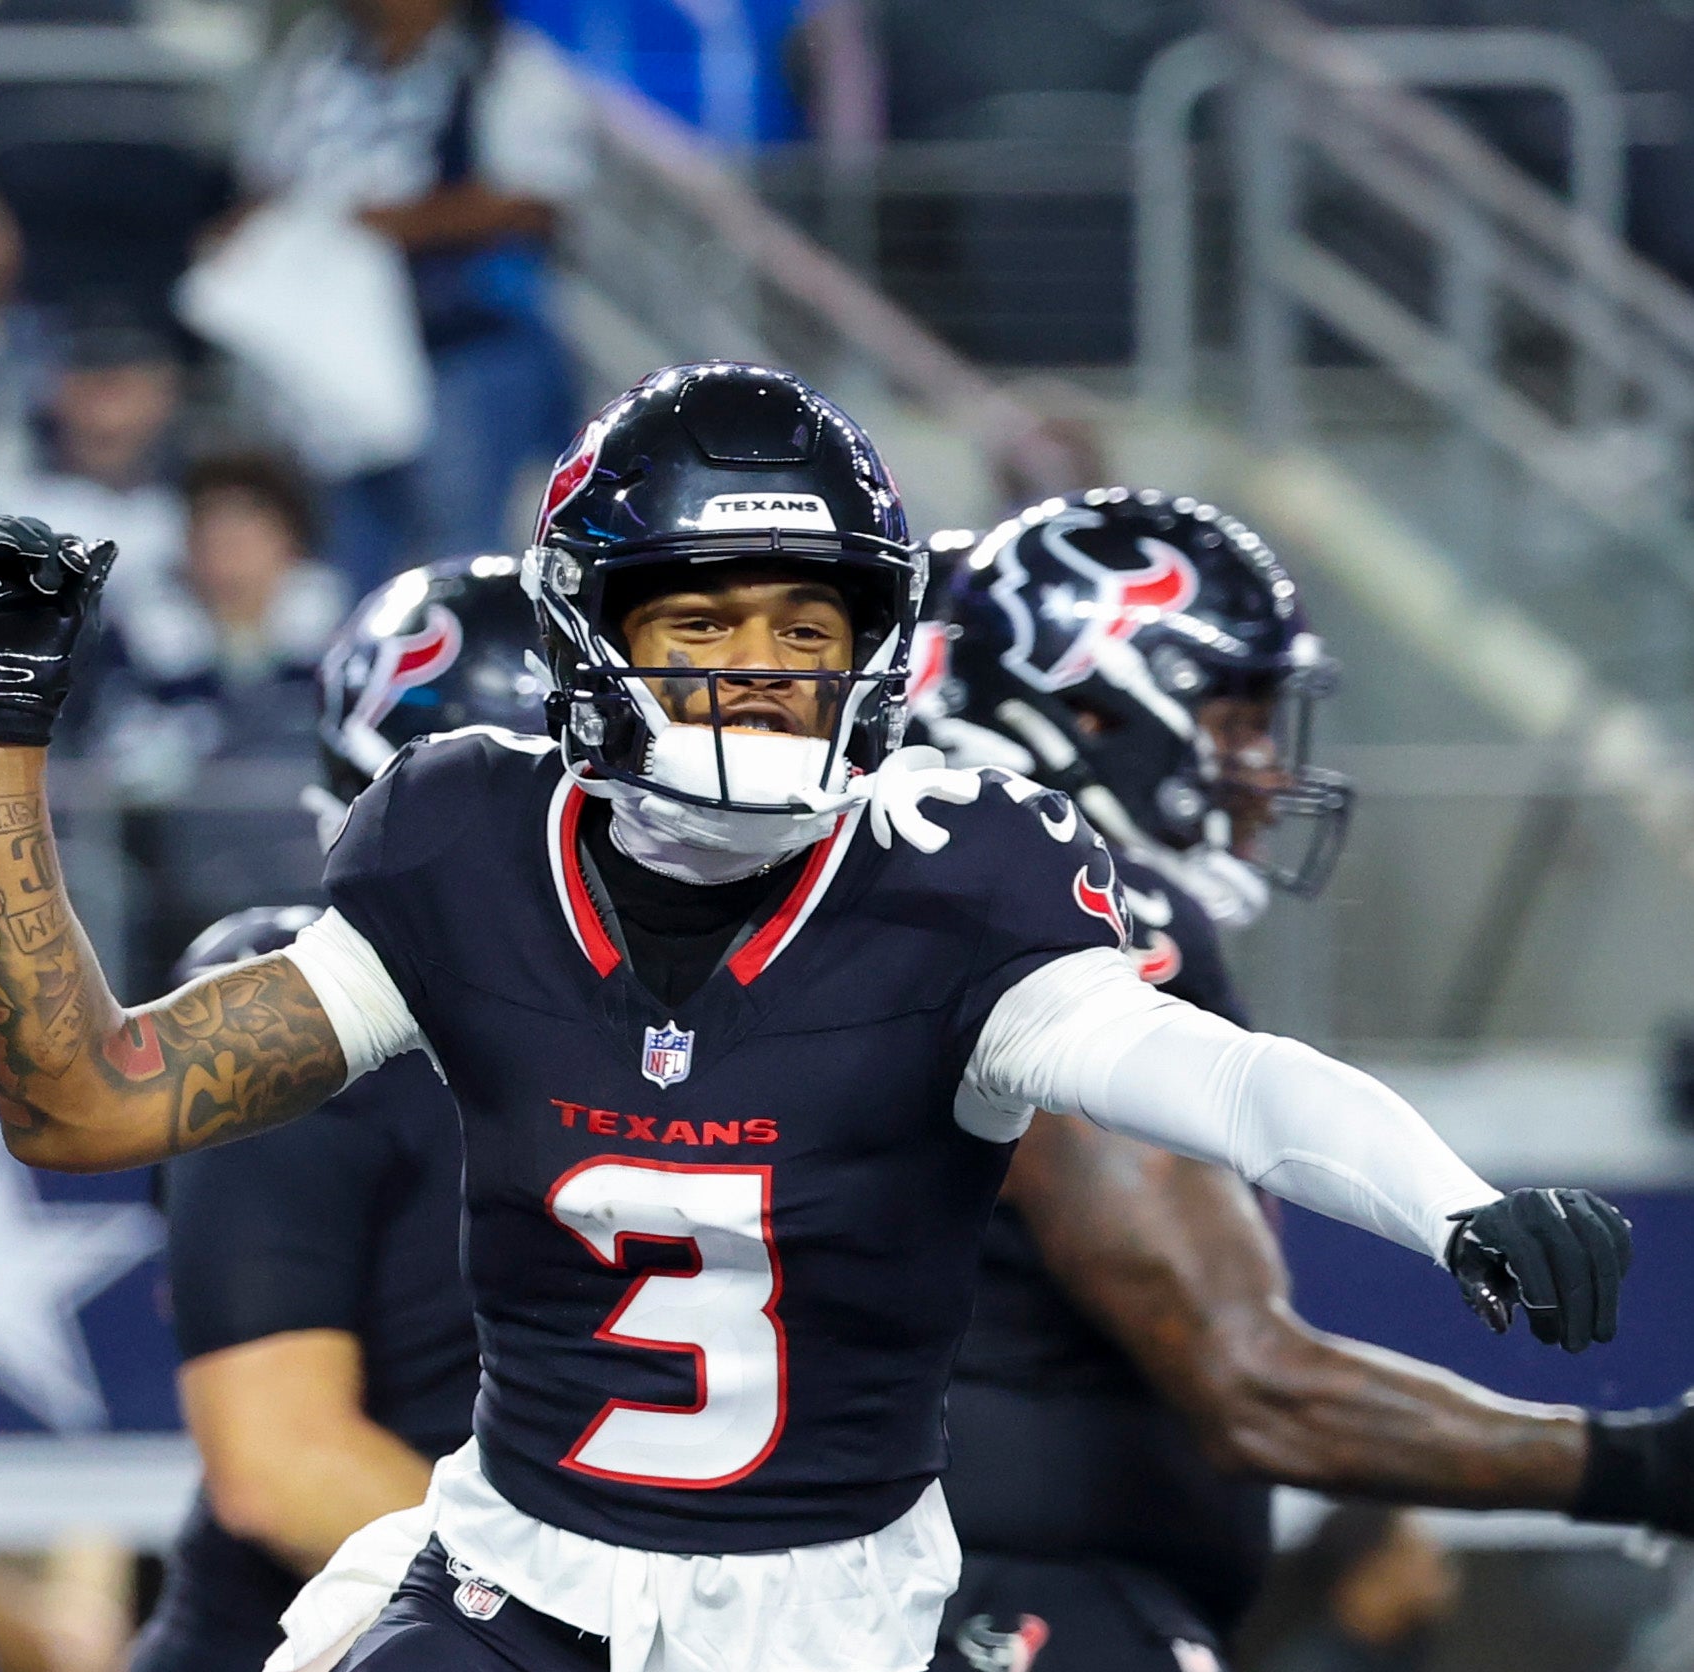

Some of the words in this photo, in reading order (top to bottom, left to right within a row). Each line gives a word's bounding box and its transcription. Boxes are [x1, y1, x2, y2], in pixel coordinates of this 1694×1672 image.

[715, 501, 819, 512] TEXANS
[650, 1051, 681, 1076] NFL
[550, 1099, 780, 1146] TEXANS
[545, 1153, 789, 1490] 3
[462, 1583, 495, 1612] NFL
